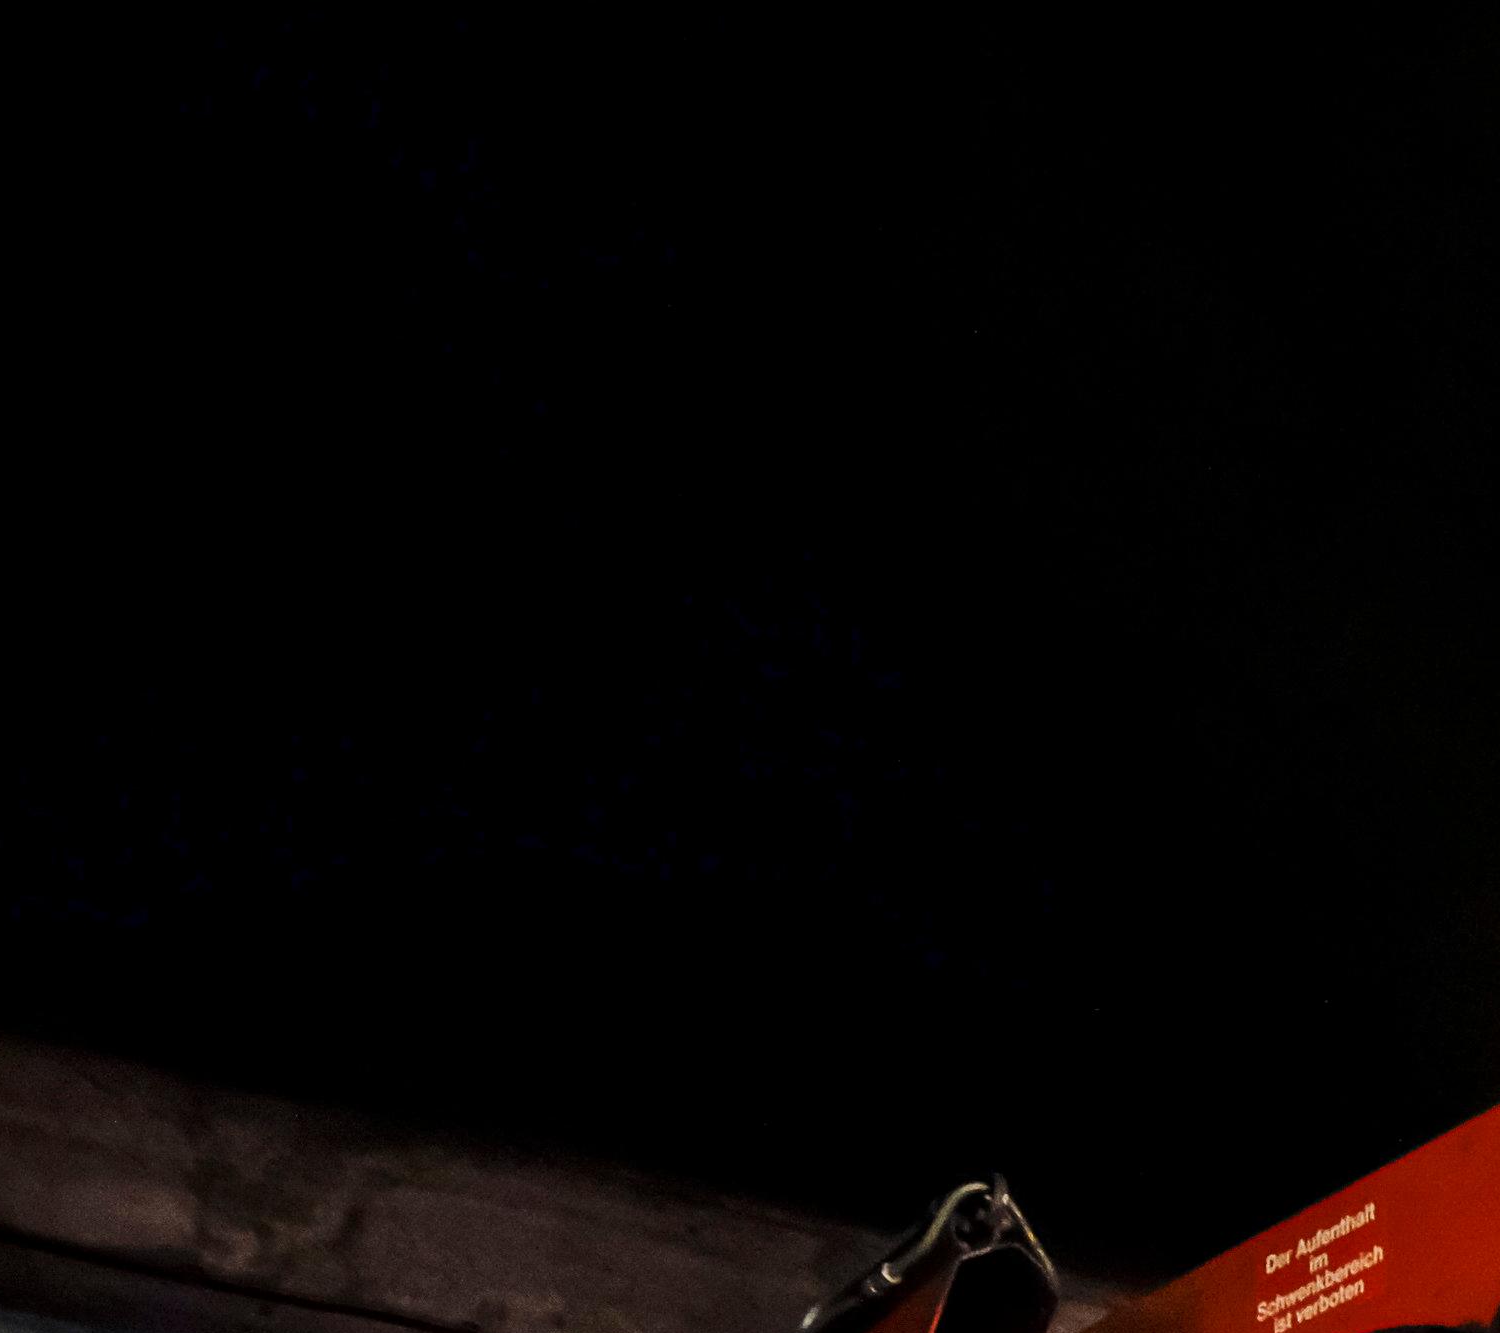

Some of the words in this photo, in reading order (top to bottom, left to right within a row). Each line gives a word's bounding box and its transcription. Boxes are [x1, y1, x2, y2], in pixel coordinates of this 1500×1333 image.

[1266, 1249, 1293, 1275] Der
[1295, 1202, 1376, 1260] Aufenthalt
[1309, 1252, 1329, 1274] im
[1257, 1244, 1384, 1322] Schwenkbereich
[1296, 1279, 1365, 1324] verboten
